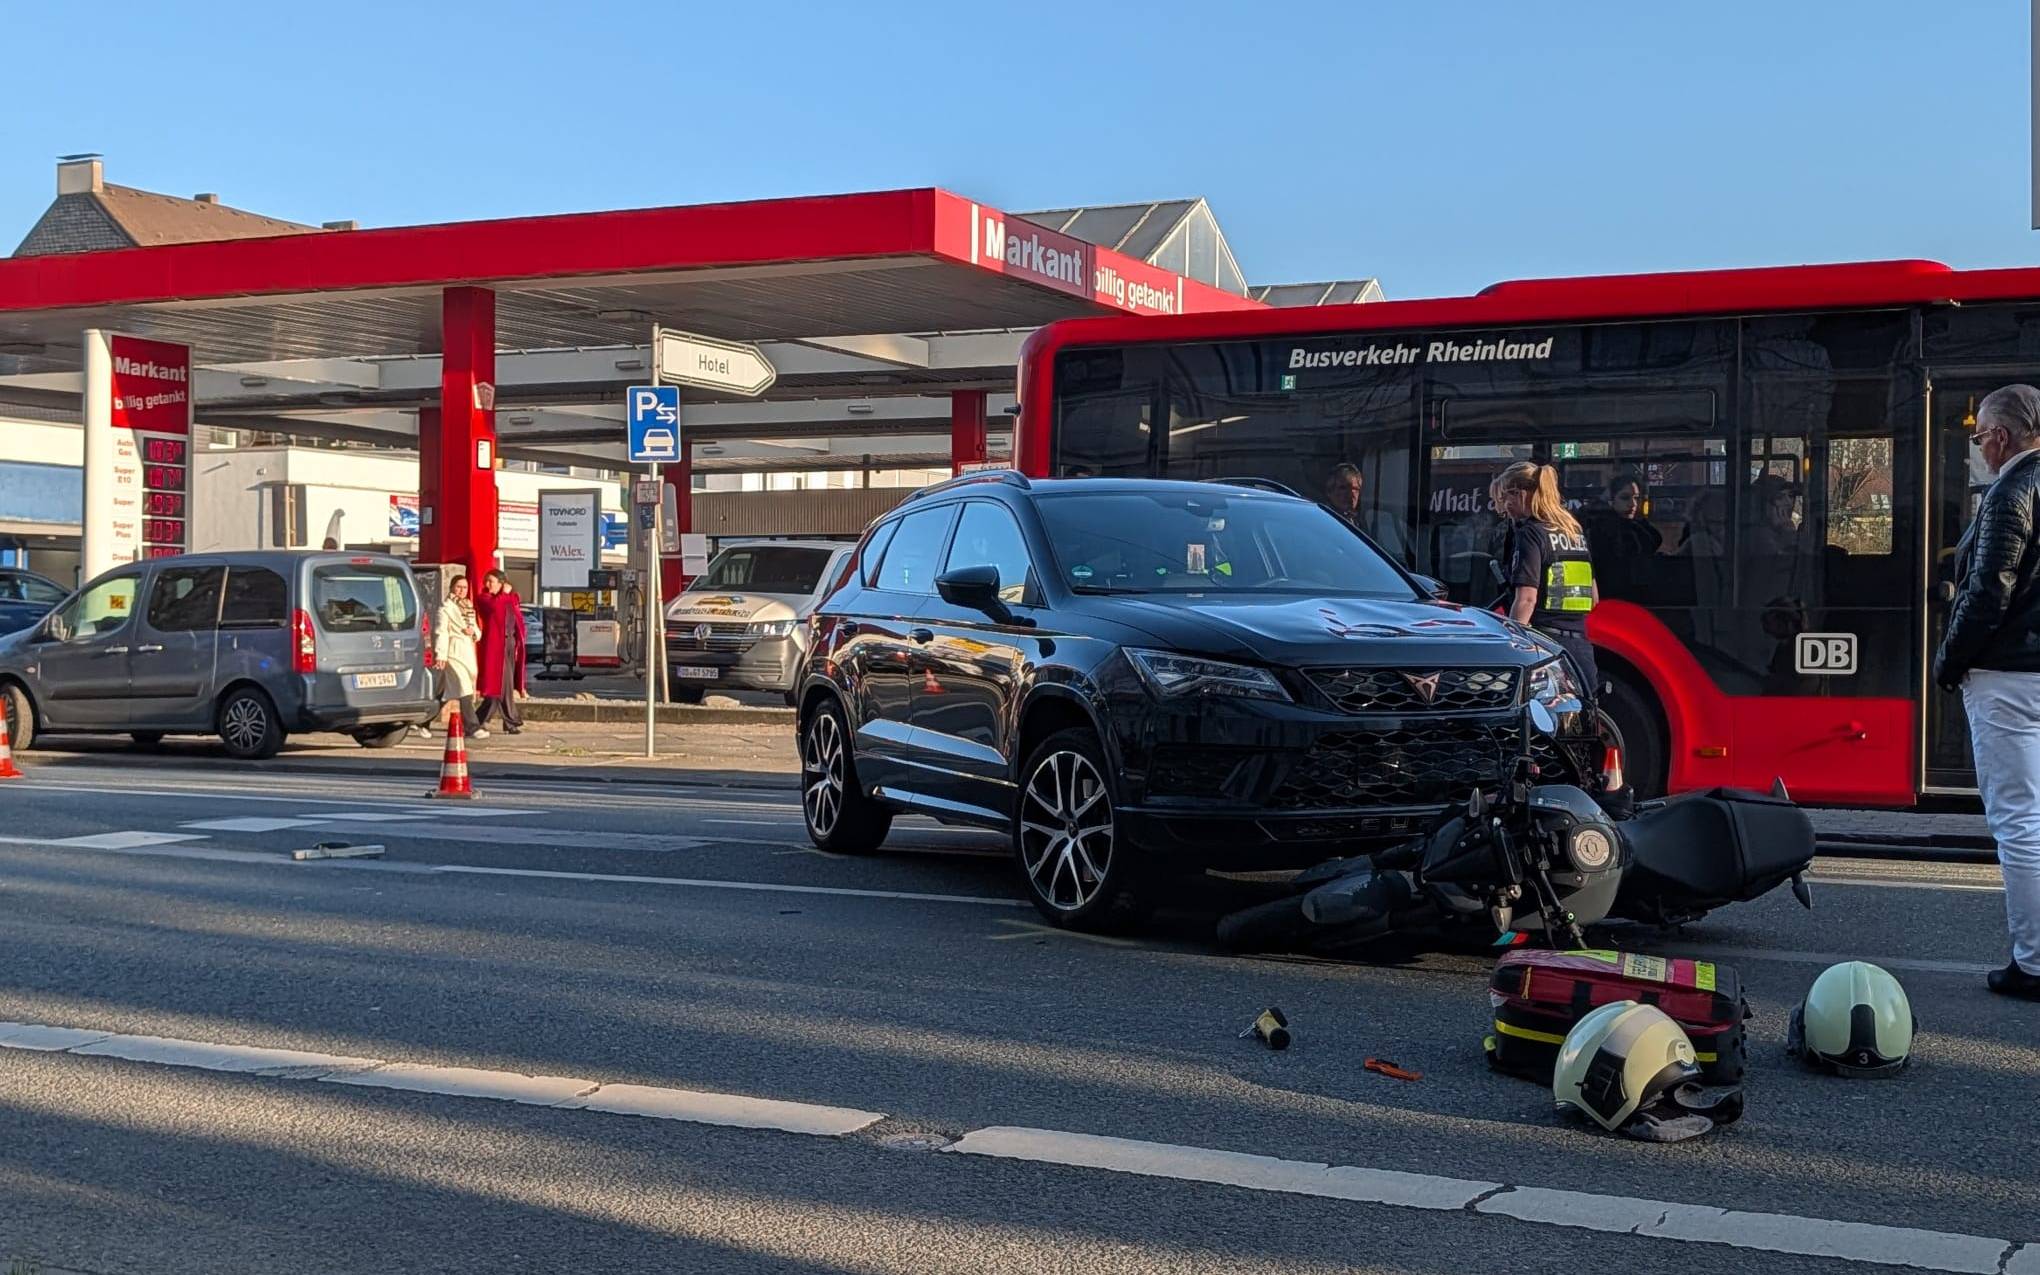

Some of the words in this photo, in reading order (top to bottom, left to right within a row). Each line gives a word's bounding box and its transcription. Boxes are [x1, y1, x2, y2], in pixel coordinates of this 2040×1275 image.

[985, 217, 1082, 286] Markant
[1128, 281, 1174, 315] getankt
[698, 354, 729, 375] Hotel
[1288, 343, 1420, 369] Busverkehr
[1426, 337, 1554, 363] Rheinland
[115, 356, 186, 381] Markant
[145, 390, 186, 409] getankt
[636, 391, 658, 421] P
[1803, 639, 1850, 668] DB
[1859, 1053, 1868, 1064] 3
